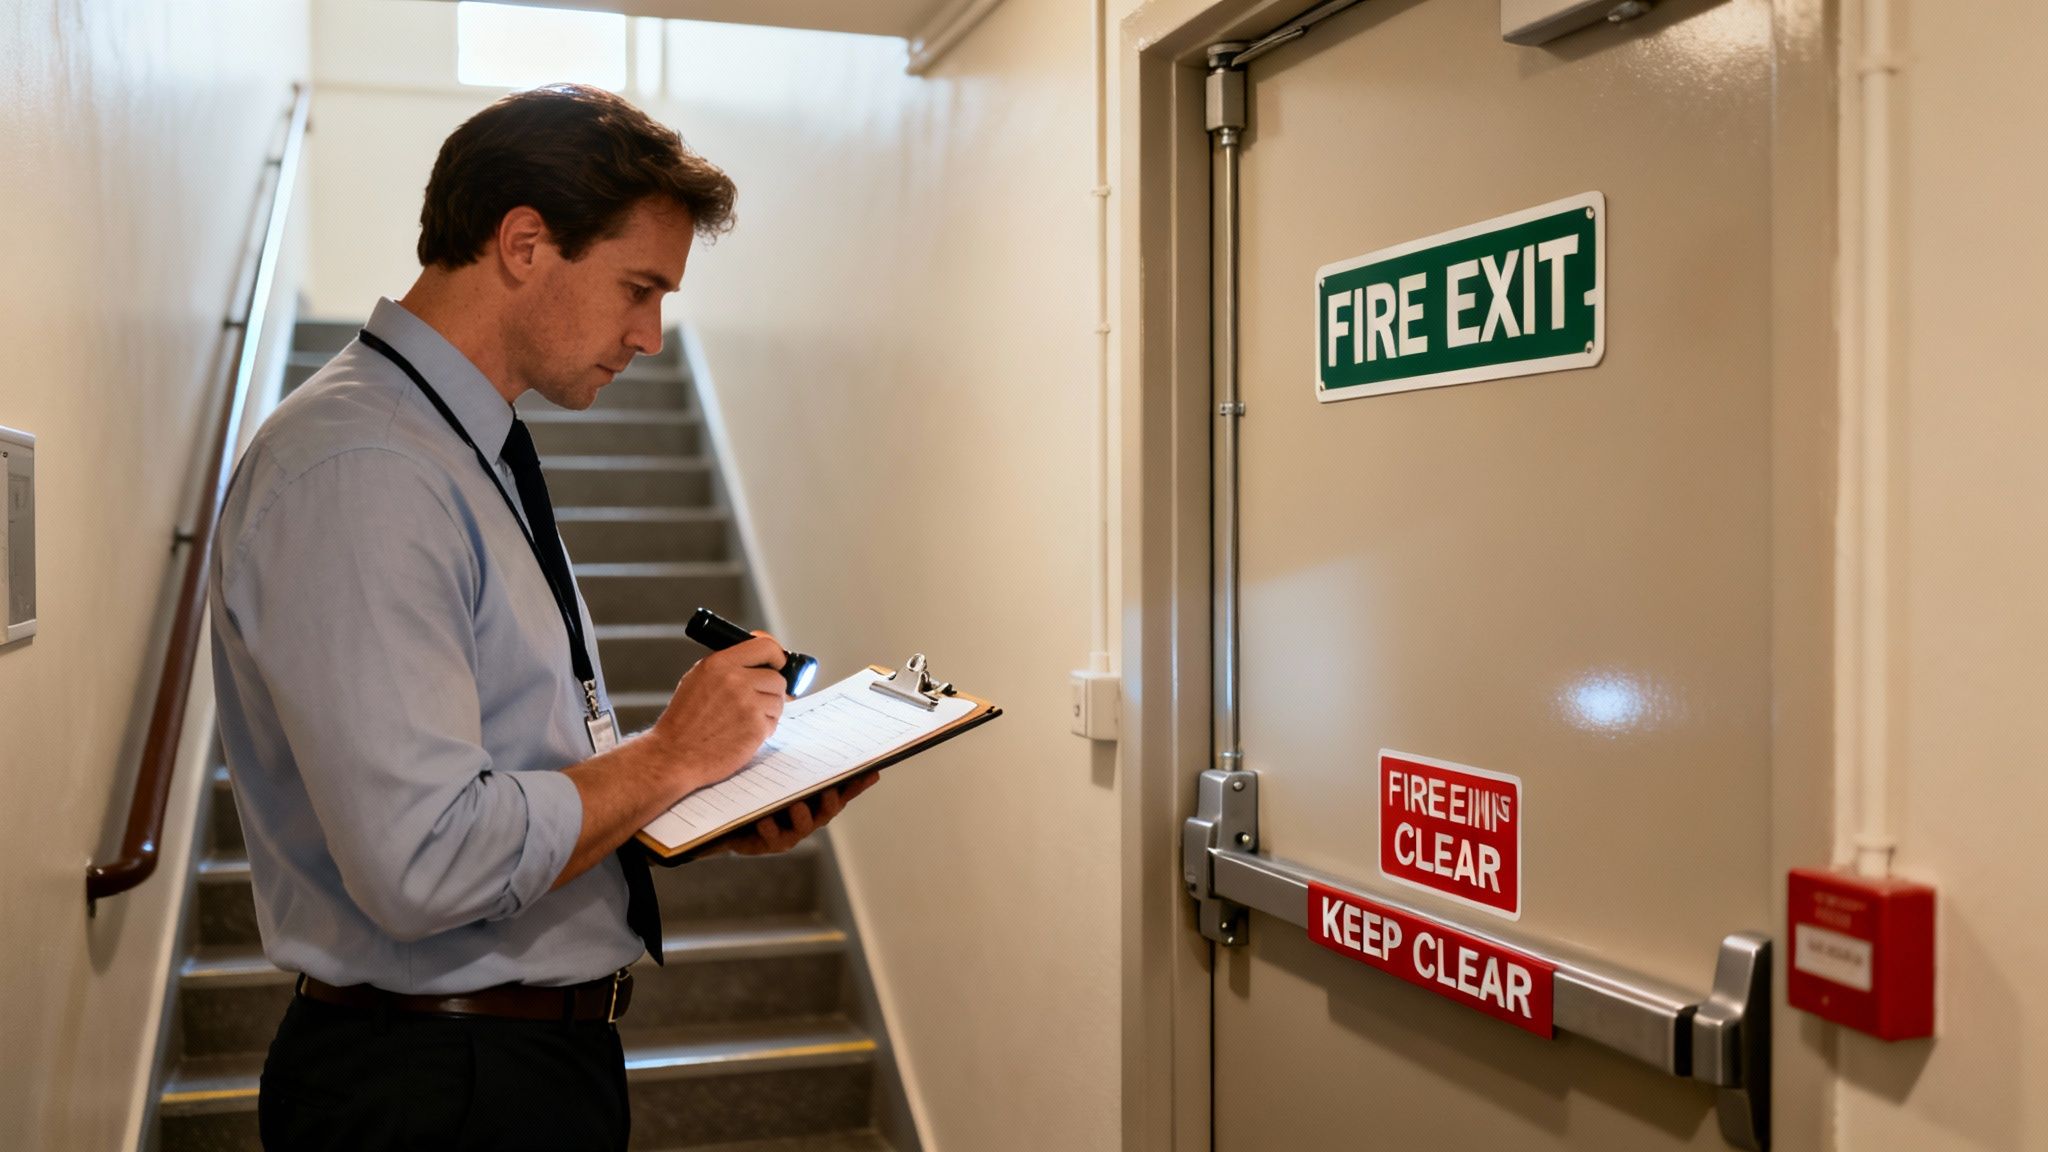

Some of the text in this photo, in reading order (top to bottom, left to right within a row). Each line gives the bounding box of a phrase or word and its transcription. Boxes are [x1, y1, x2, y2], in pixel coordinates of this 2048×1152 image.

[1328, 233, 1579, 367] FIRE EXIT
[1394, 822, 1501, 893] CLEAR
[1322, 896, 1533, 1018] KEEP CLEAR
